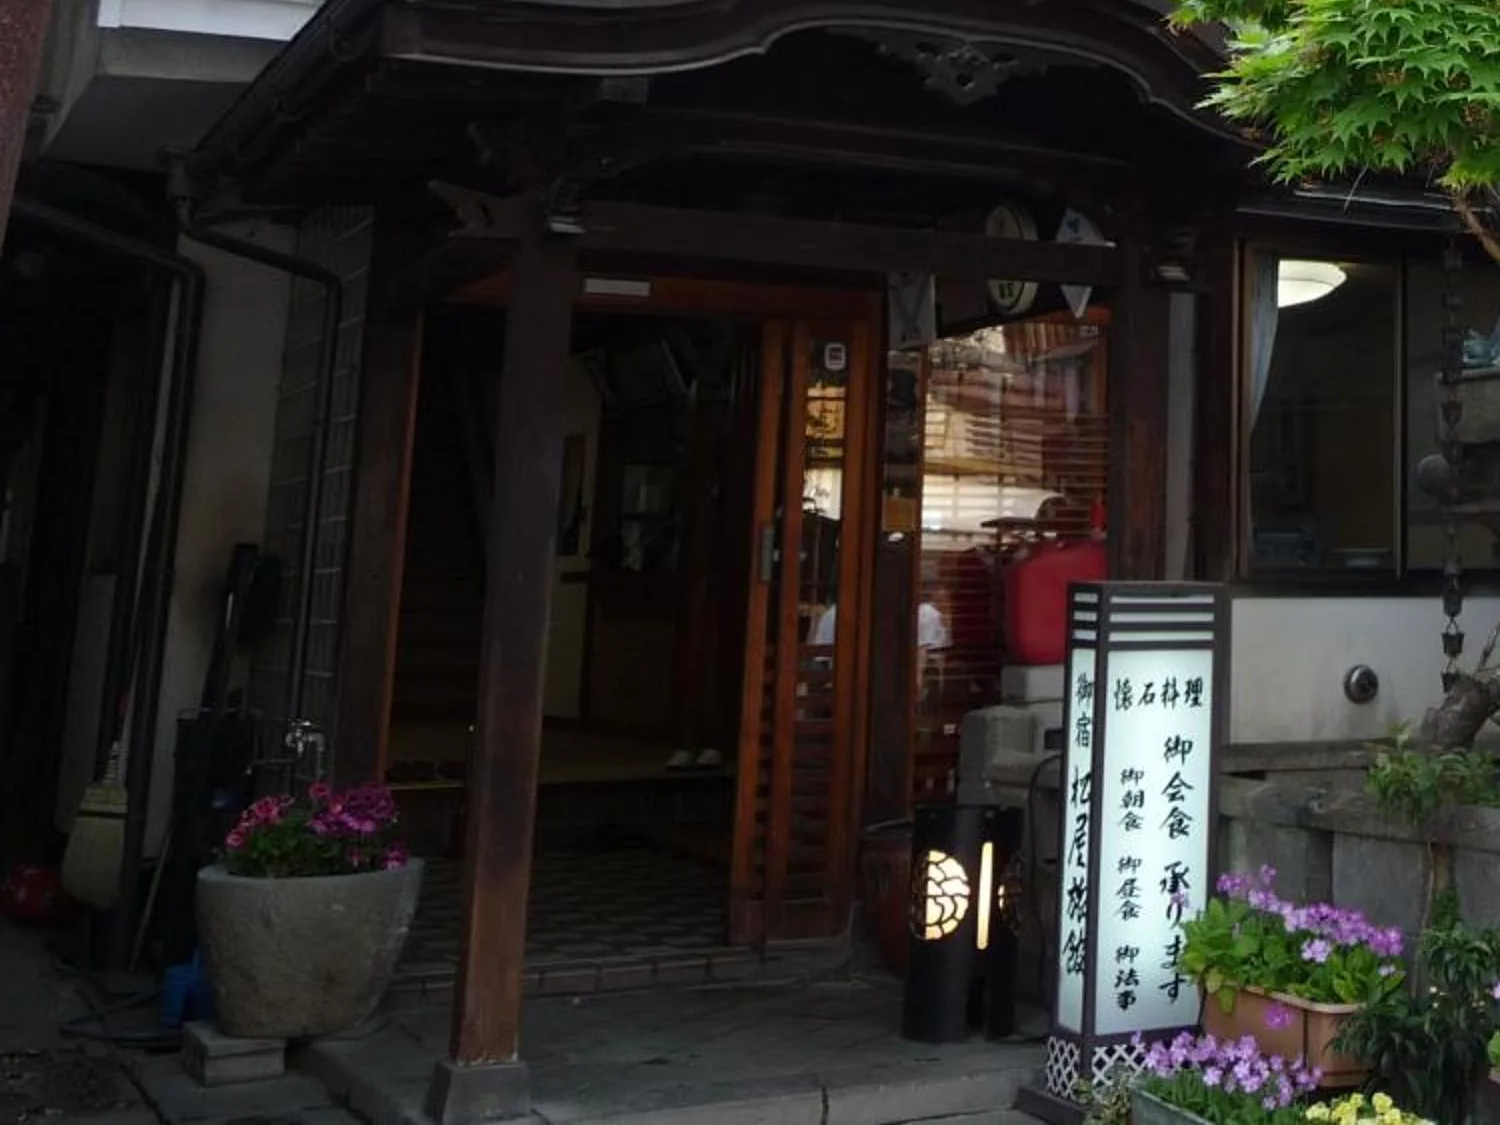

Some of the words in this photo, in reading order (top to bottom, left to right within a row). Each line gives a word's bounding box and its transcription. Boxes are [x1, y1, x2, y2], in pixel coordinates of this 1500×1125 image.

[1075, 672, 1093, 748] 御宿
[1113, 676, 1203, 710] 懐石料理
[1118, 766, 1145, 832] 御朝食
[1161, 734, 1193, 838] 御会食
[1115, 854, 1142, 921] 御昼食
[1157, 860, 1190, 1004] 承ります
[1113, 944, 1140, 1011] 御法事
